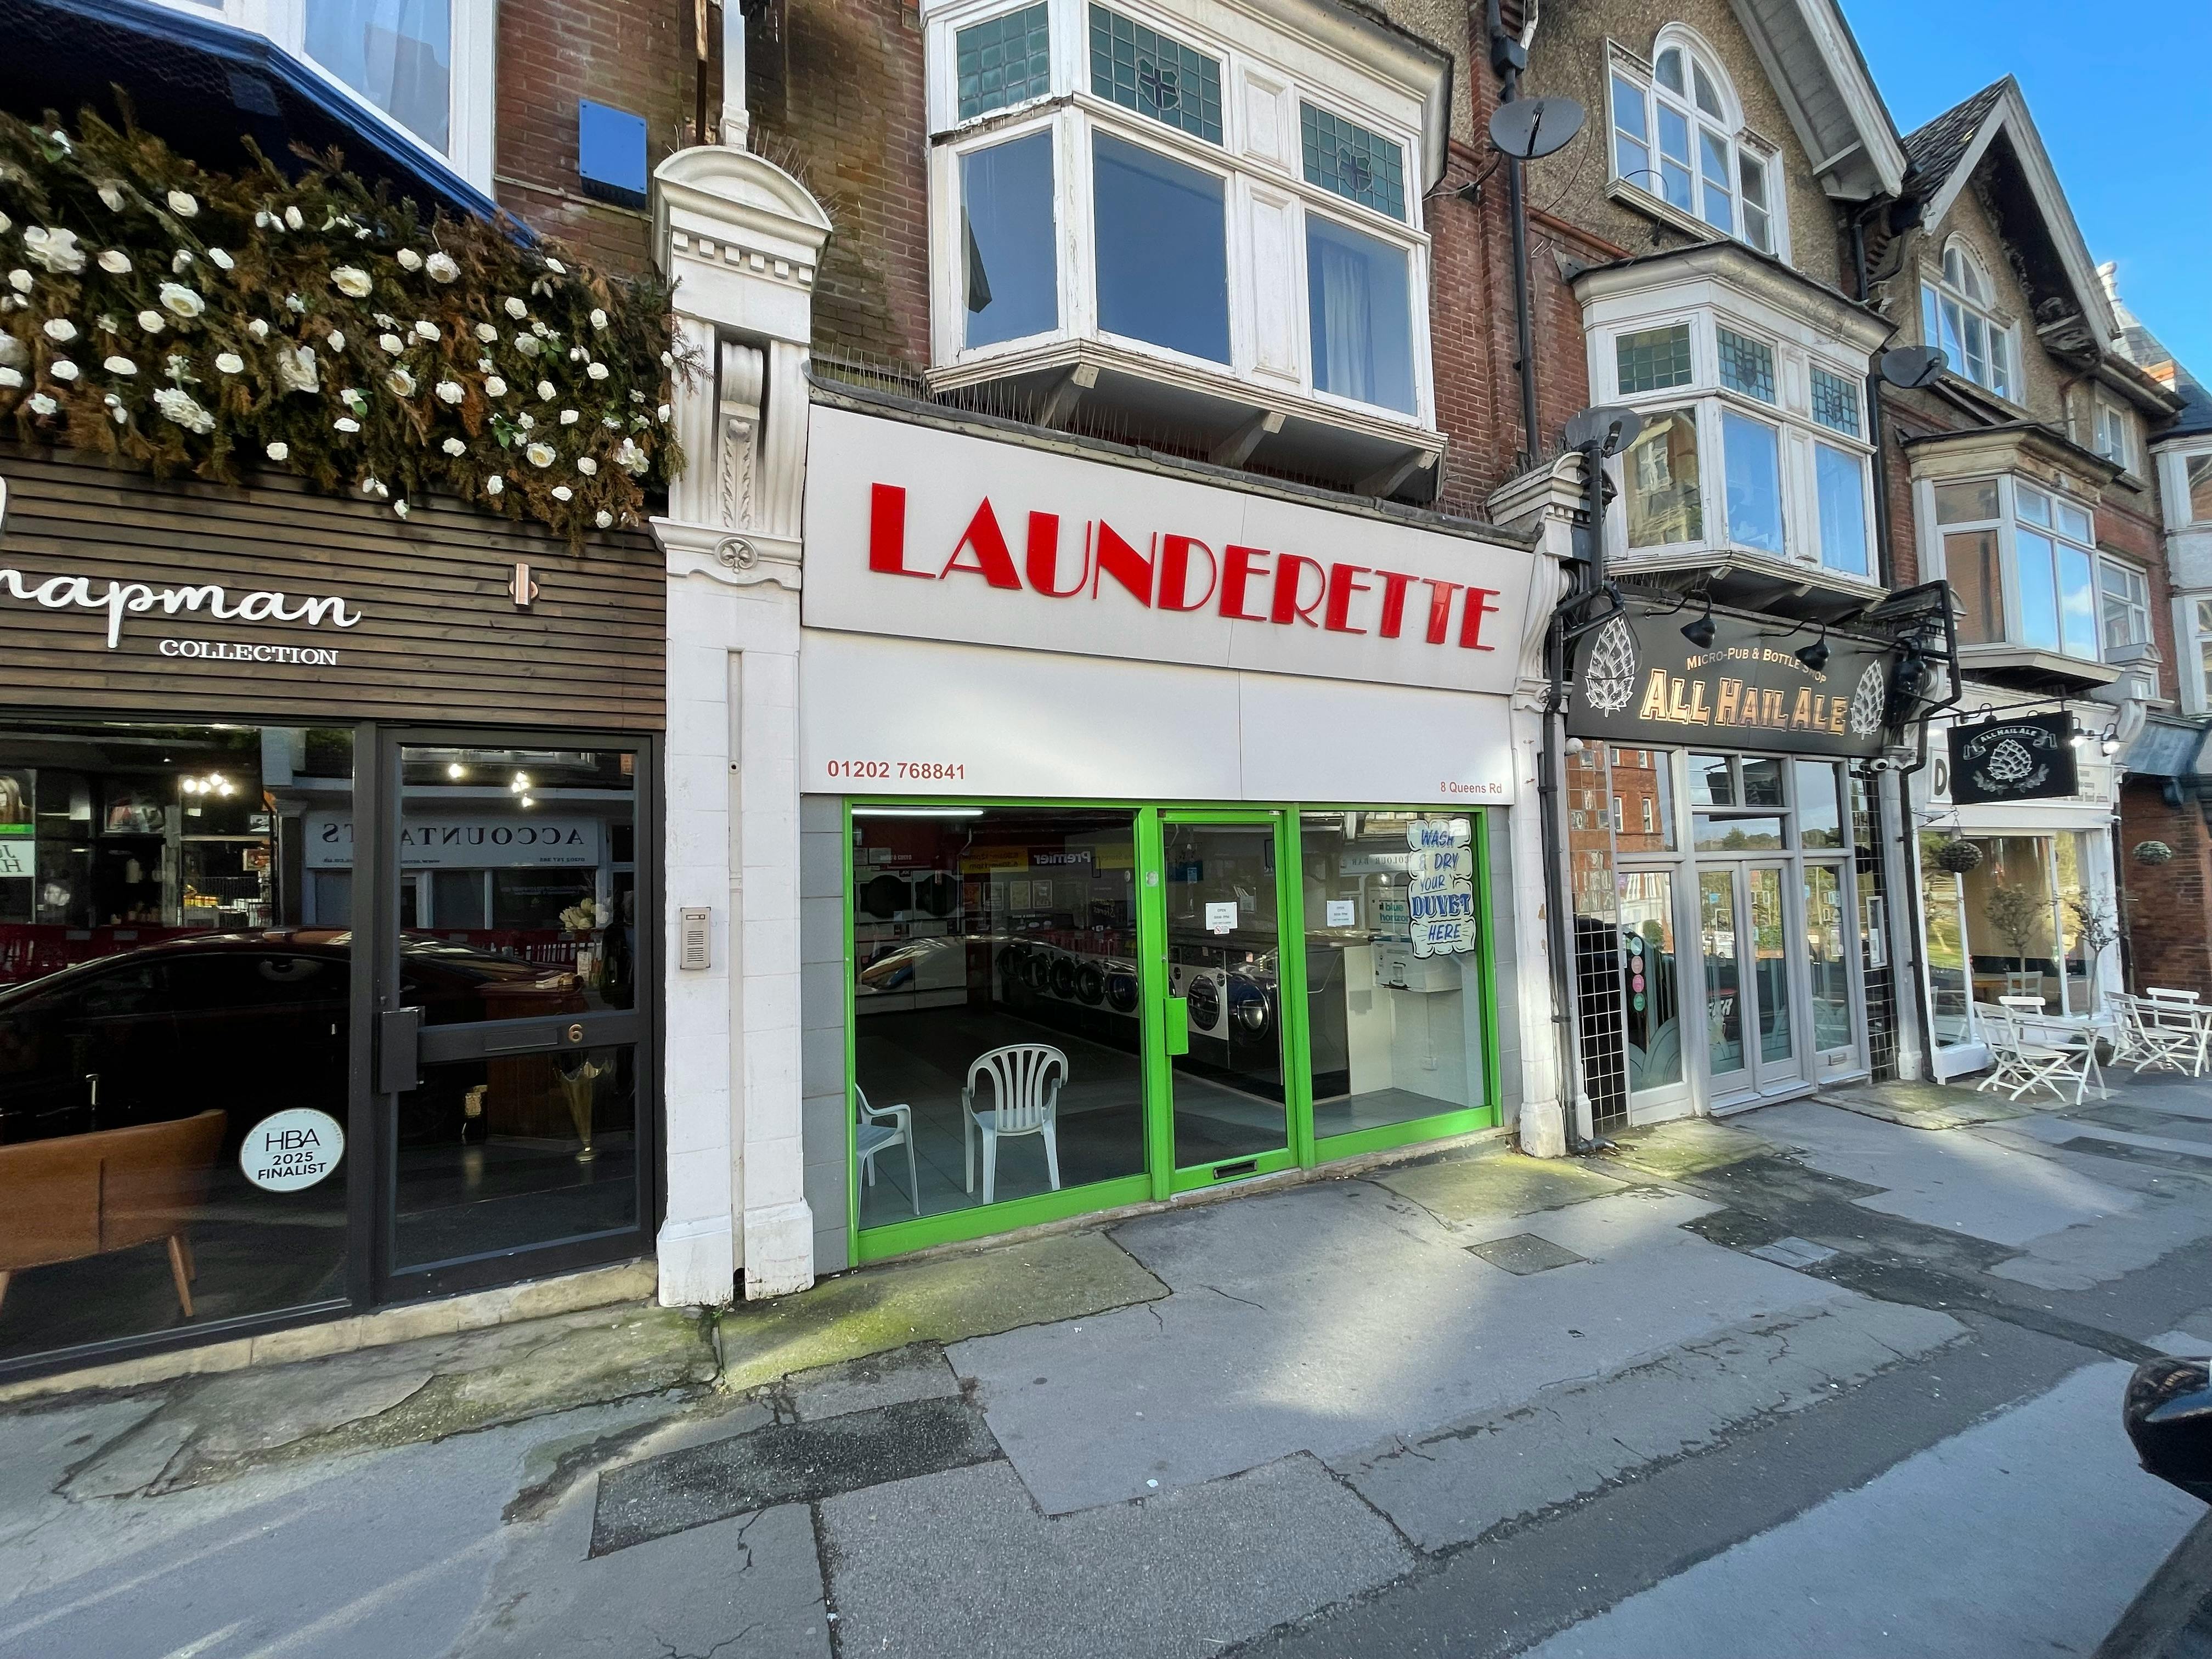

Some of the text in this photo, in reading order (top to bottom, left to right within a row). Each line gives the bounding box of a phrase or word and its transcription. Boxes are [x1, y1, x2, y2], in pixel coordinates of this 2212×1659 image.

[869, 482, 1500, 652] LAUNDERETTE
[159, 639, 339, 667] COLLECTION
[1751, 647, 1760, 660] &
[1639, 668, 1849, 736] ALL HAIL ALE
[827, 760, 966, 781] 01202 768841
[1440, 781, 1503, 795] 8 Queens Rd
[1421, 829, 1454, 848] WASH
[1434, 853, 1459, 872] DRY
[1420, 874, 1446, 891] YOUR
[1385, 902, 1404, 912] blue
[1412, 893, 1471, 918] DUVET
[1428, 923, 1462, 941] HERE
[567, 1023, 583, 1043] 6
[266, 1128, 320, 1152] HBA
[272, 1151, 314, 1166] 2025
[257, 1162, 327, 1181] FINALIST
